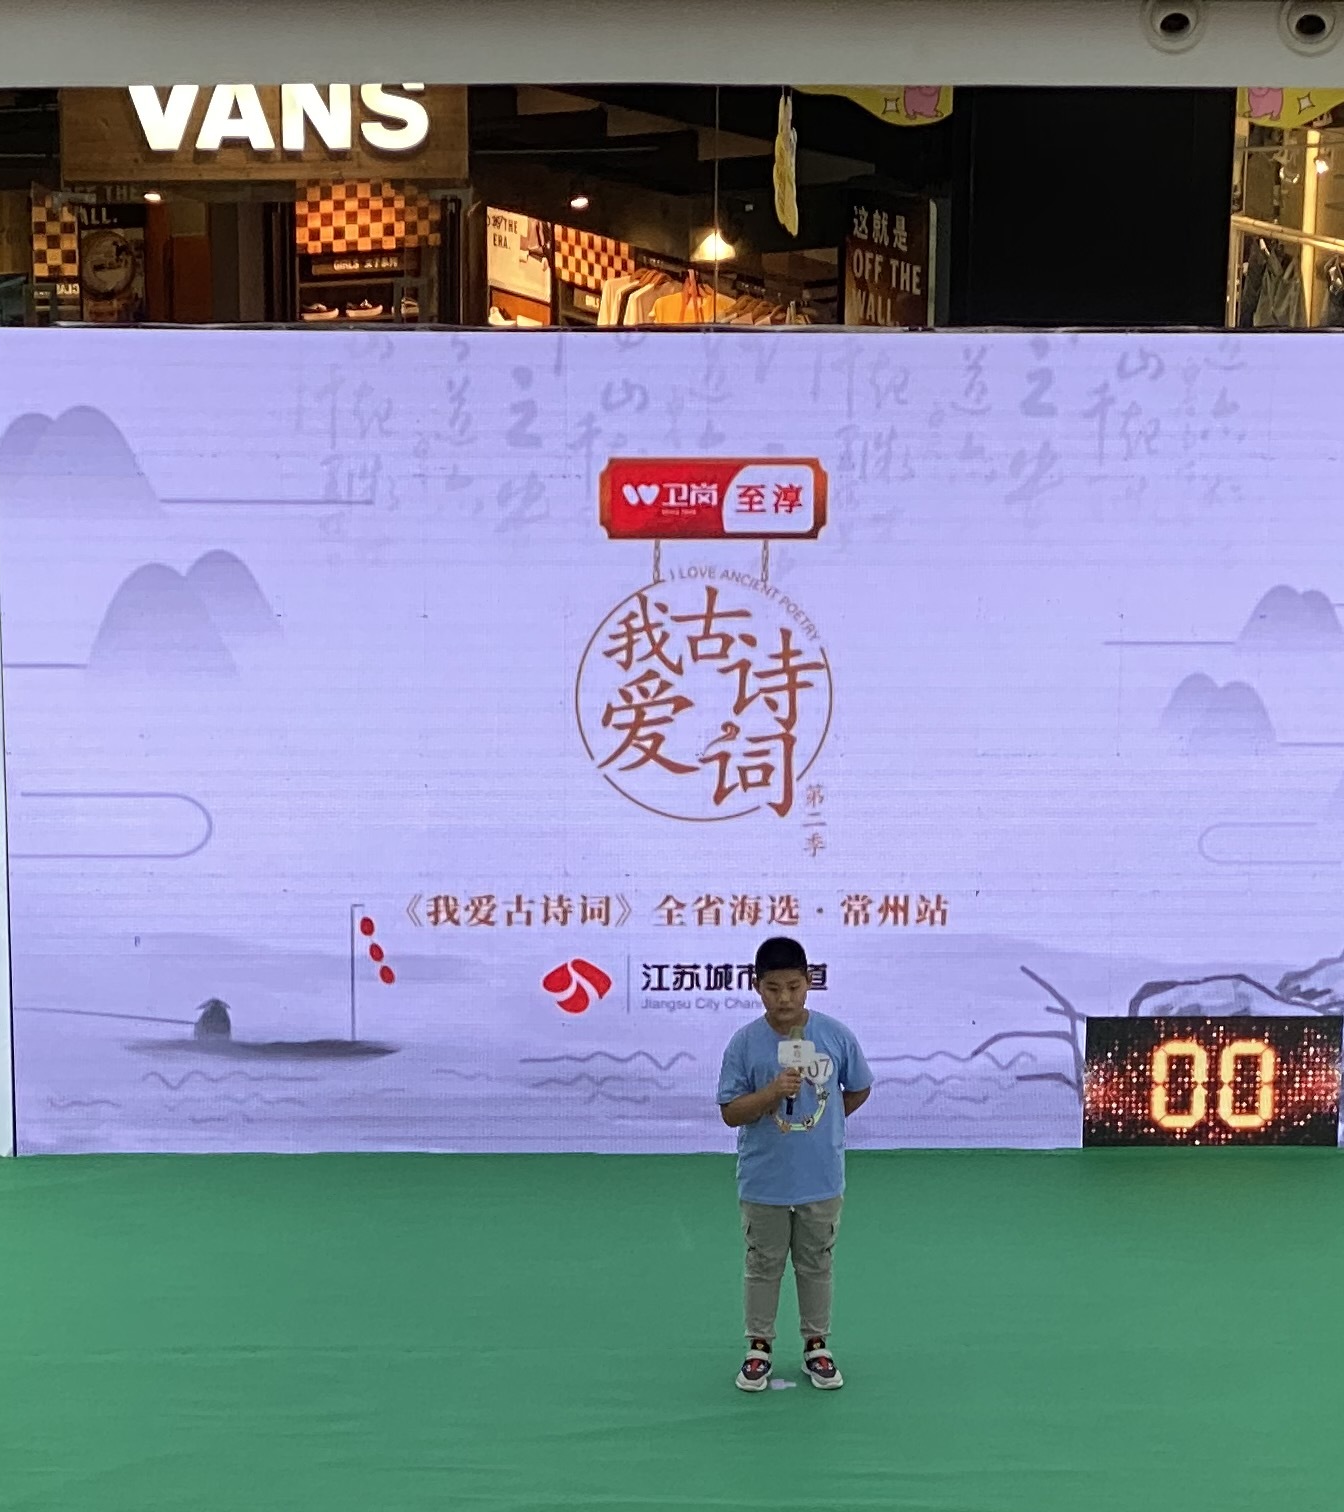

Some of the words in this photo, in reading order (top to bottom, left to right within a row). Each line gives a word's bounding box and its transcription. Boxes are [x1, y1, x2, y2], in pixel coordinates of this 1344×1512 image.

[128, 82, 431, 152] VANS
[77, 205, 119, 226] ALL.
[853, 205, 908, 252] 这就是
[853, 248, 884, 284] OFF
[890, 258, 922, 296] THE
[661, 482, 718, 507] 卫岗
[735, 484, 803, 514] 至淳
[679, 565, 716, 580] LOVE
[719, 569, 780, 600] ANCIENT
[778, 595, 821, 642] POETRY
[802, 784, 828, 857] 第二季
[641, 963, 829, 991] 江苏城市道
[641, 999, 692, 1012] Jiangsu
[695, 998, 720, 1013] City
[724, 998, 764, 1010] Chan
[1151, 1037, 1276, 1129] 00
